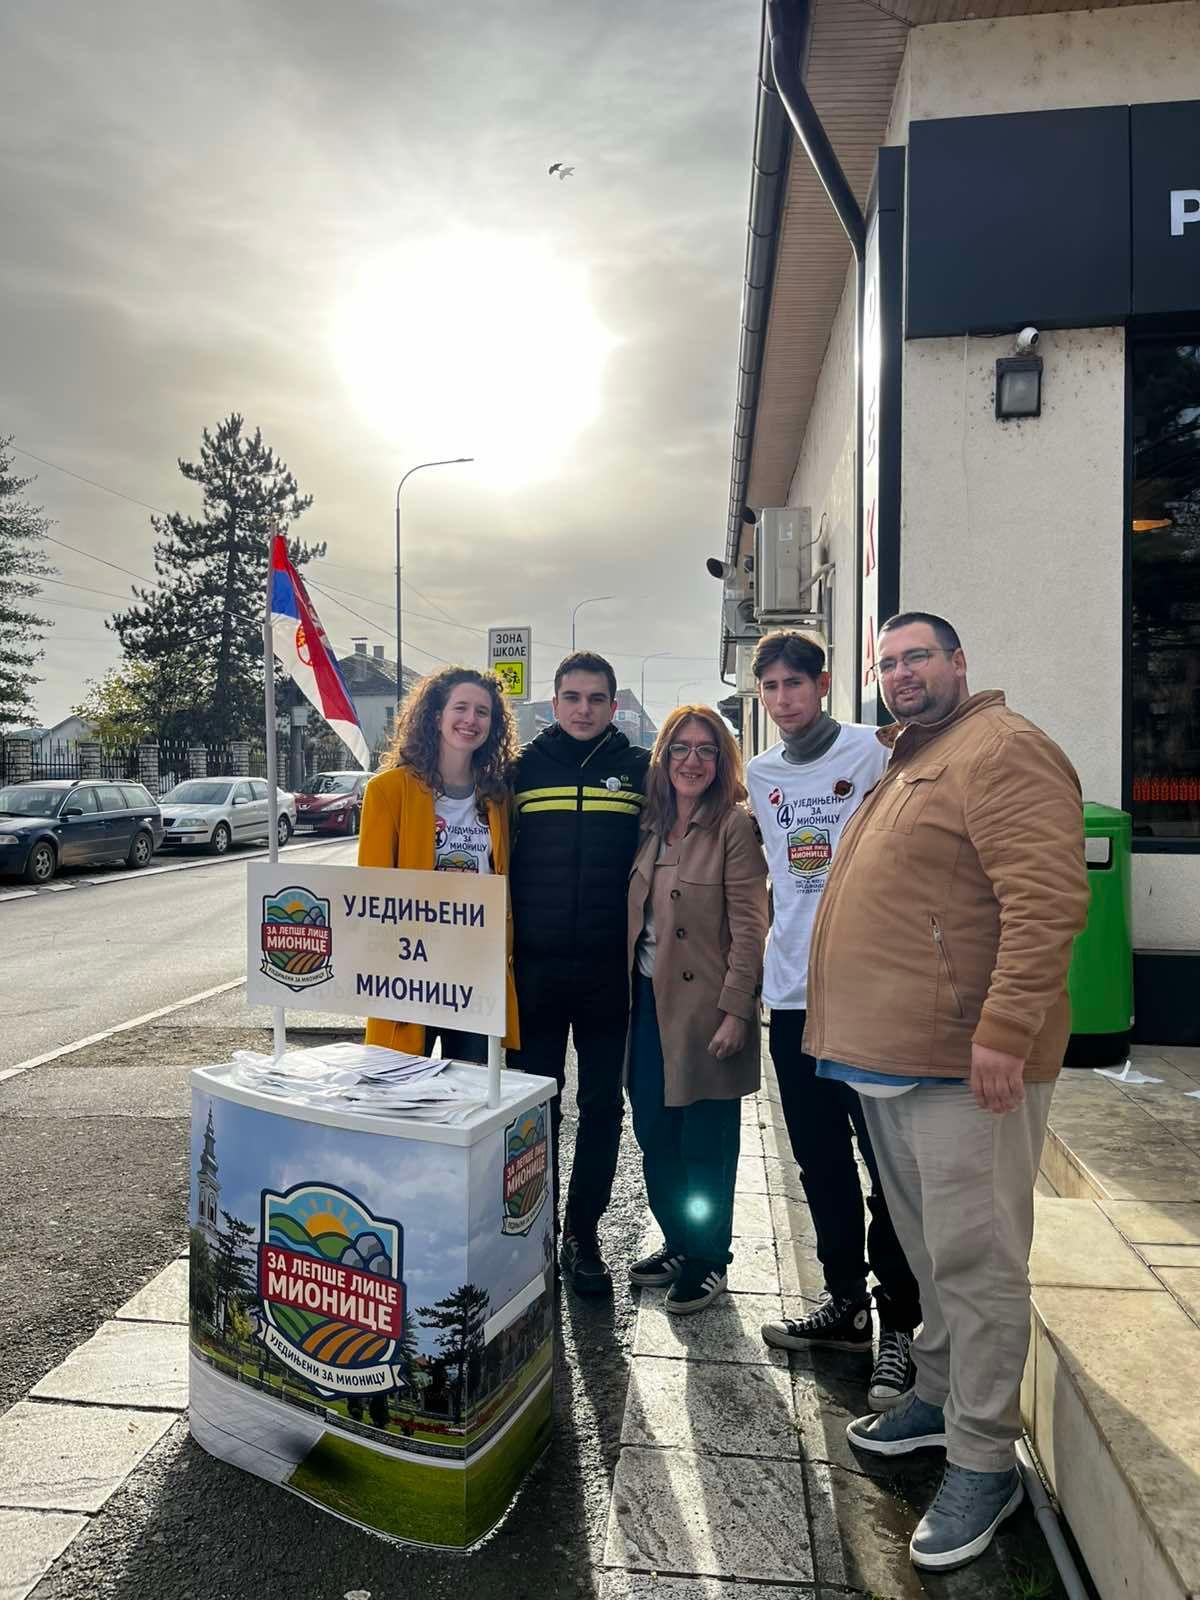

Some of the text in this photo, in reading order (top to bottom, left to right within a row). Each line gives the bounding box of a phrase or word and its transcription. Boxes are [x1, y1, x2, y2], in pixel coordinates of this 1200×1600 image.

[496, 633, 523, 644] ЗОНА
[493, 646, 527, 657] ШКОЛЕ
[780, 806, 790, 826] 4
[797, 814, 841, 826] МИОНИЦУ
[811, 807, 822, 816] ЗА
[343, 894, 485, 928] УЈЕДИЊЕНИ
[266, 926, 329, 940] ЗА ЛЕПШЕ ЛИЦЕ
[267, 936, 327, 953] МИОНИЦЕ
[398, 937, 428, 962] ЗА
[356, 973, 474, 1013] МИОНИЦУ
[267, 1252, 398, 1305] ЗА ЛЕПШЕ ЛИЦЕ
[268, 1271, 393, 1332] МИОНИЦЕ
[269, 1333, 386, 1386] УЈЕДИЊЕНИ ЗА МИОНИЦУ
